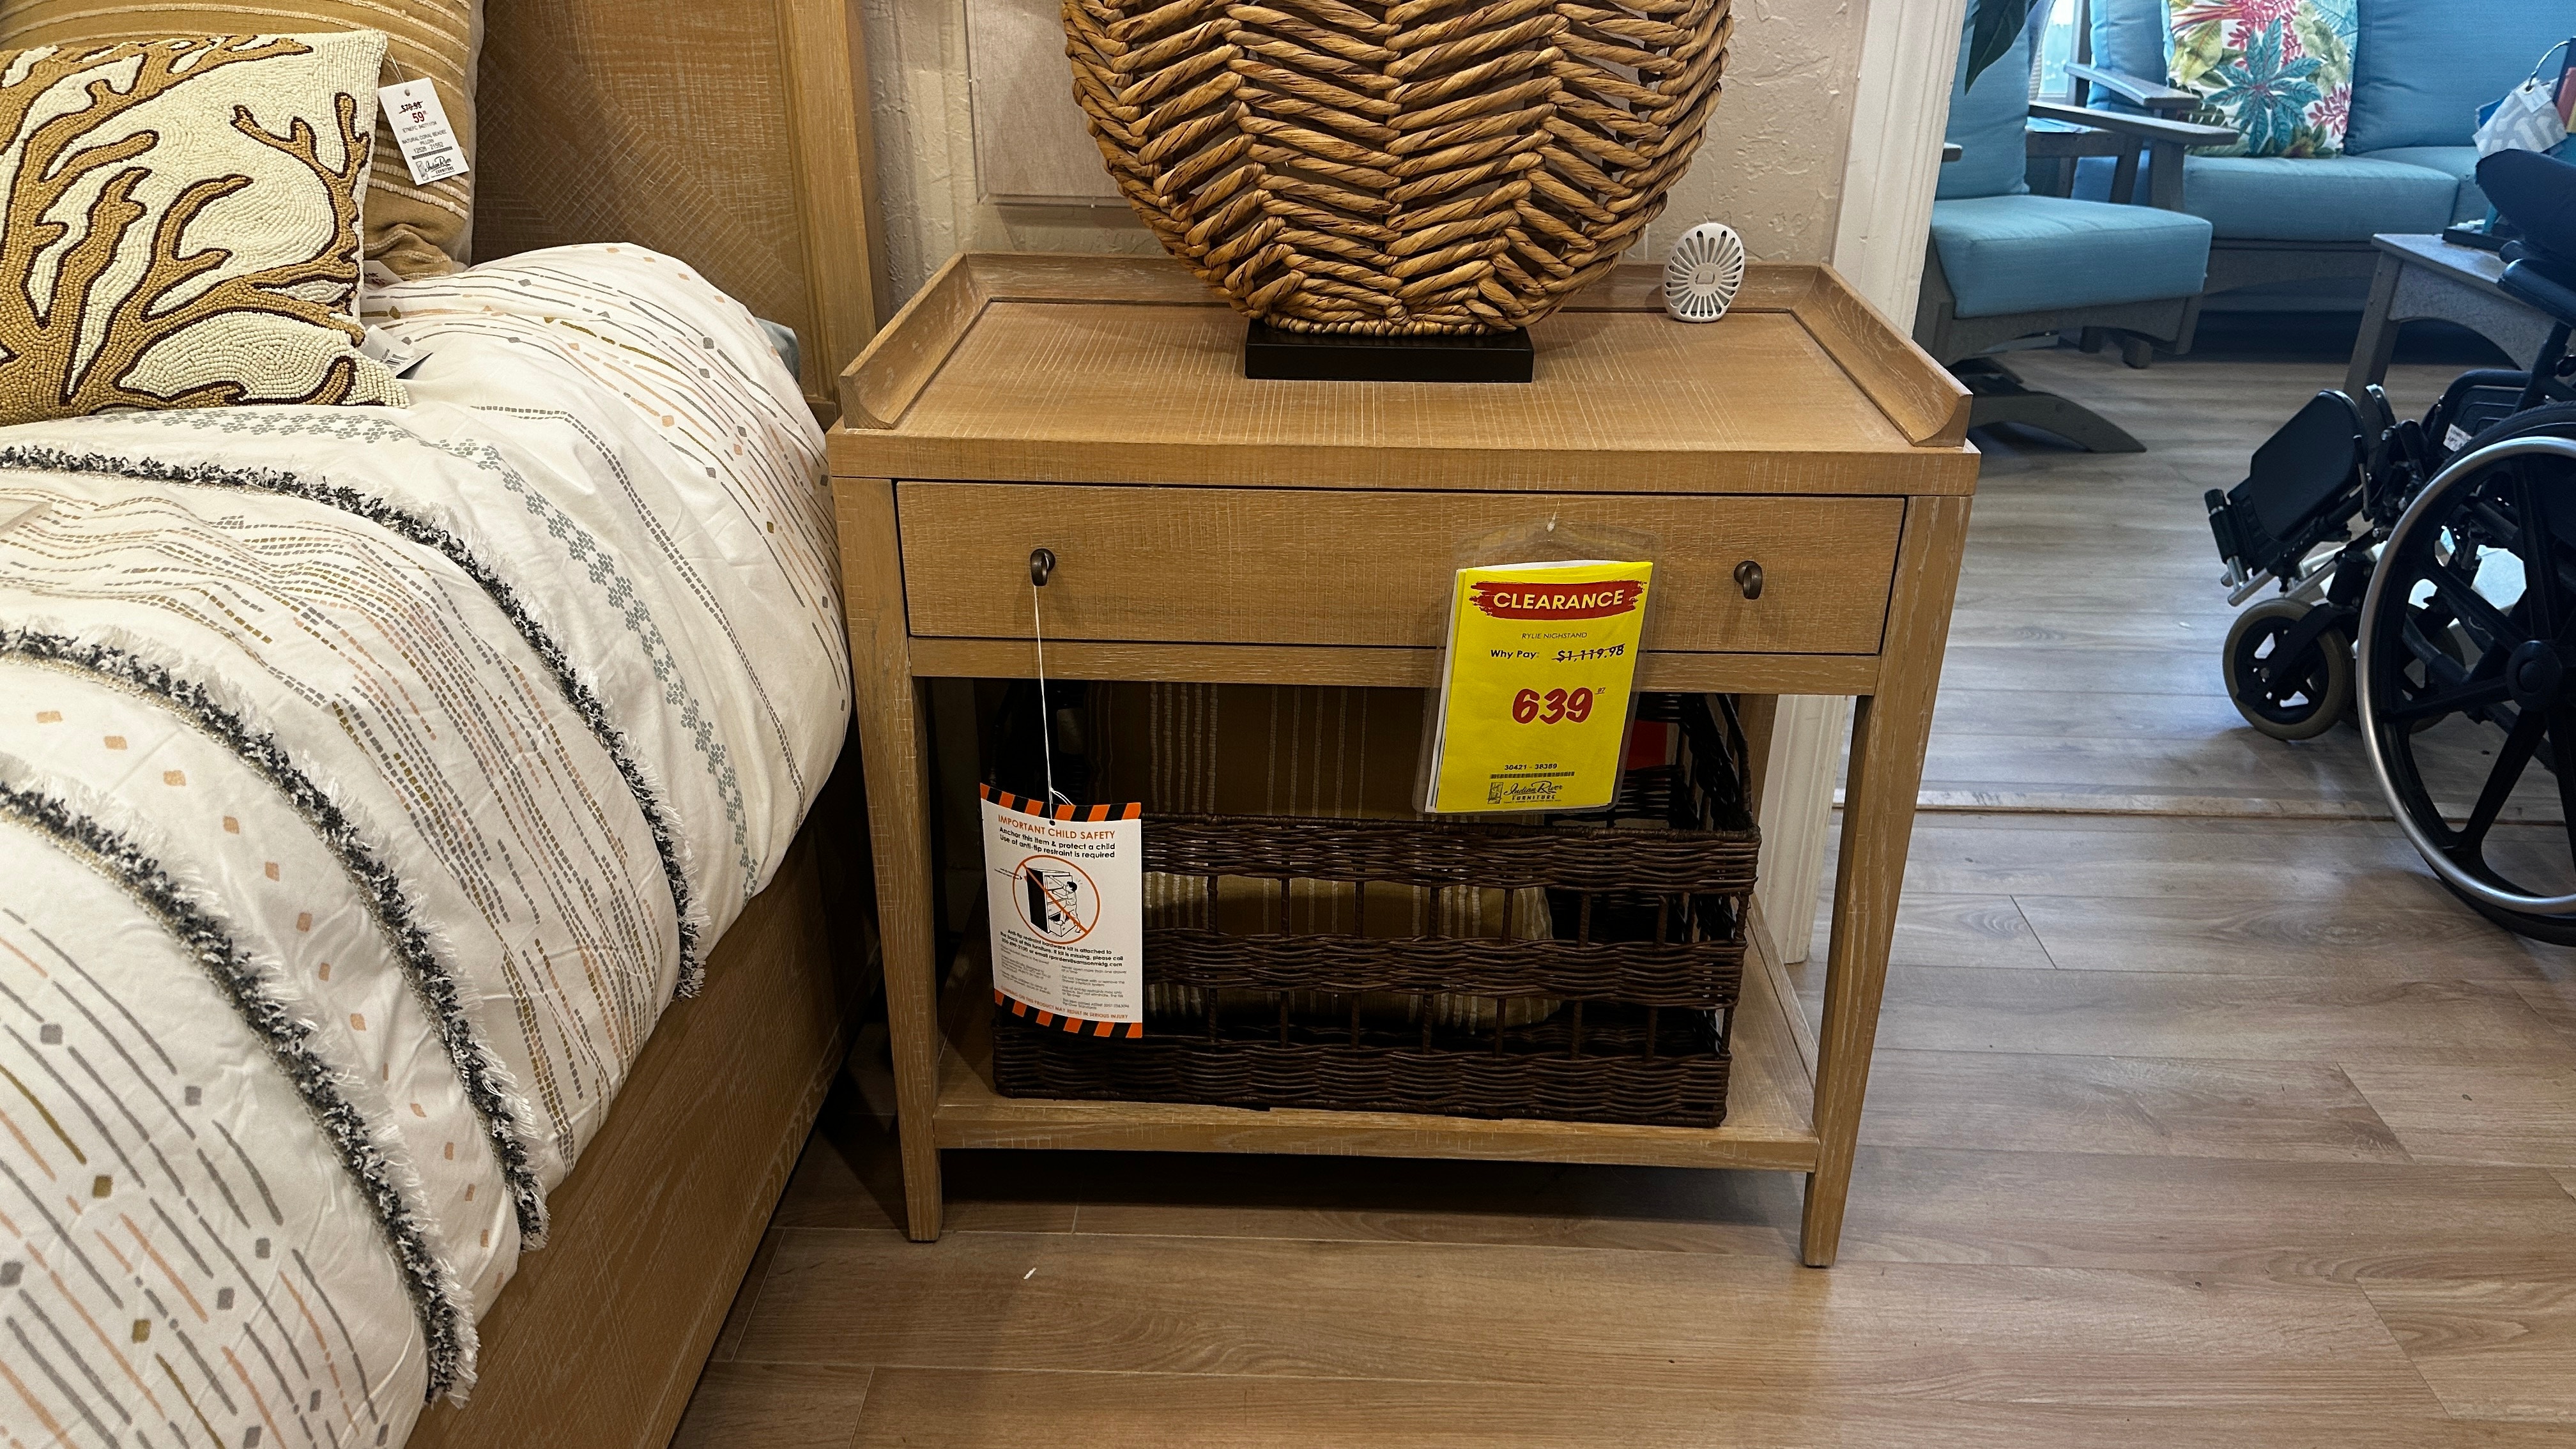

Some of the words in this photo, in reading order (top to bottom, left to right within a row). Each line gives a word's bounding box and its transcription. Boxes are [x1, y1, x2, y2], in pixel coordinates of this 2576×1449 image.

[412, 111, 425, 123] 59
[1493, 589, 1625, 610] CLEARANCE
[1491, 649, 1514, 659] Why
[1556, 644, 1625, 663] $1,119.98
[1512, 687, 1593, 725] 639
[1503, 783, 1537, 796] Indian
[998, 814, 1046, 834] IMPORTANT
[1048, 828, 1077, 839] CHILD
[1080, 831, 1116, 840] SAFETY
[999, 827, 1021, 839] Anchor
[1022, 834, 1033, 843] this
[1034, 836, 1050, 846] item
[999, 834, 1010, 843] Use
[1019, 841, 1042, 853] anti-tip
[1043, 847, 1073, 857] restraint
[1082, 851, 1116, 860] required
